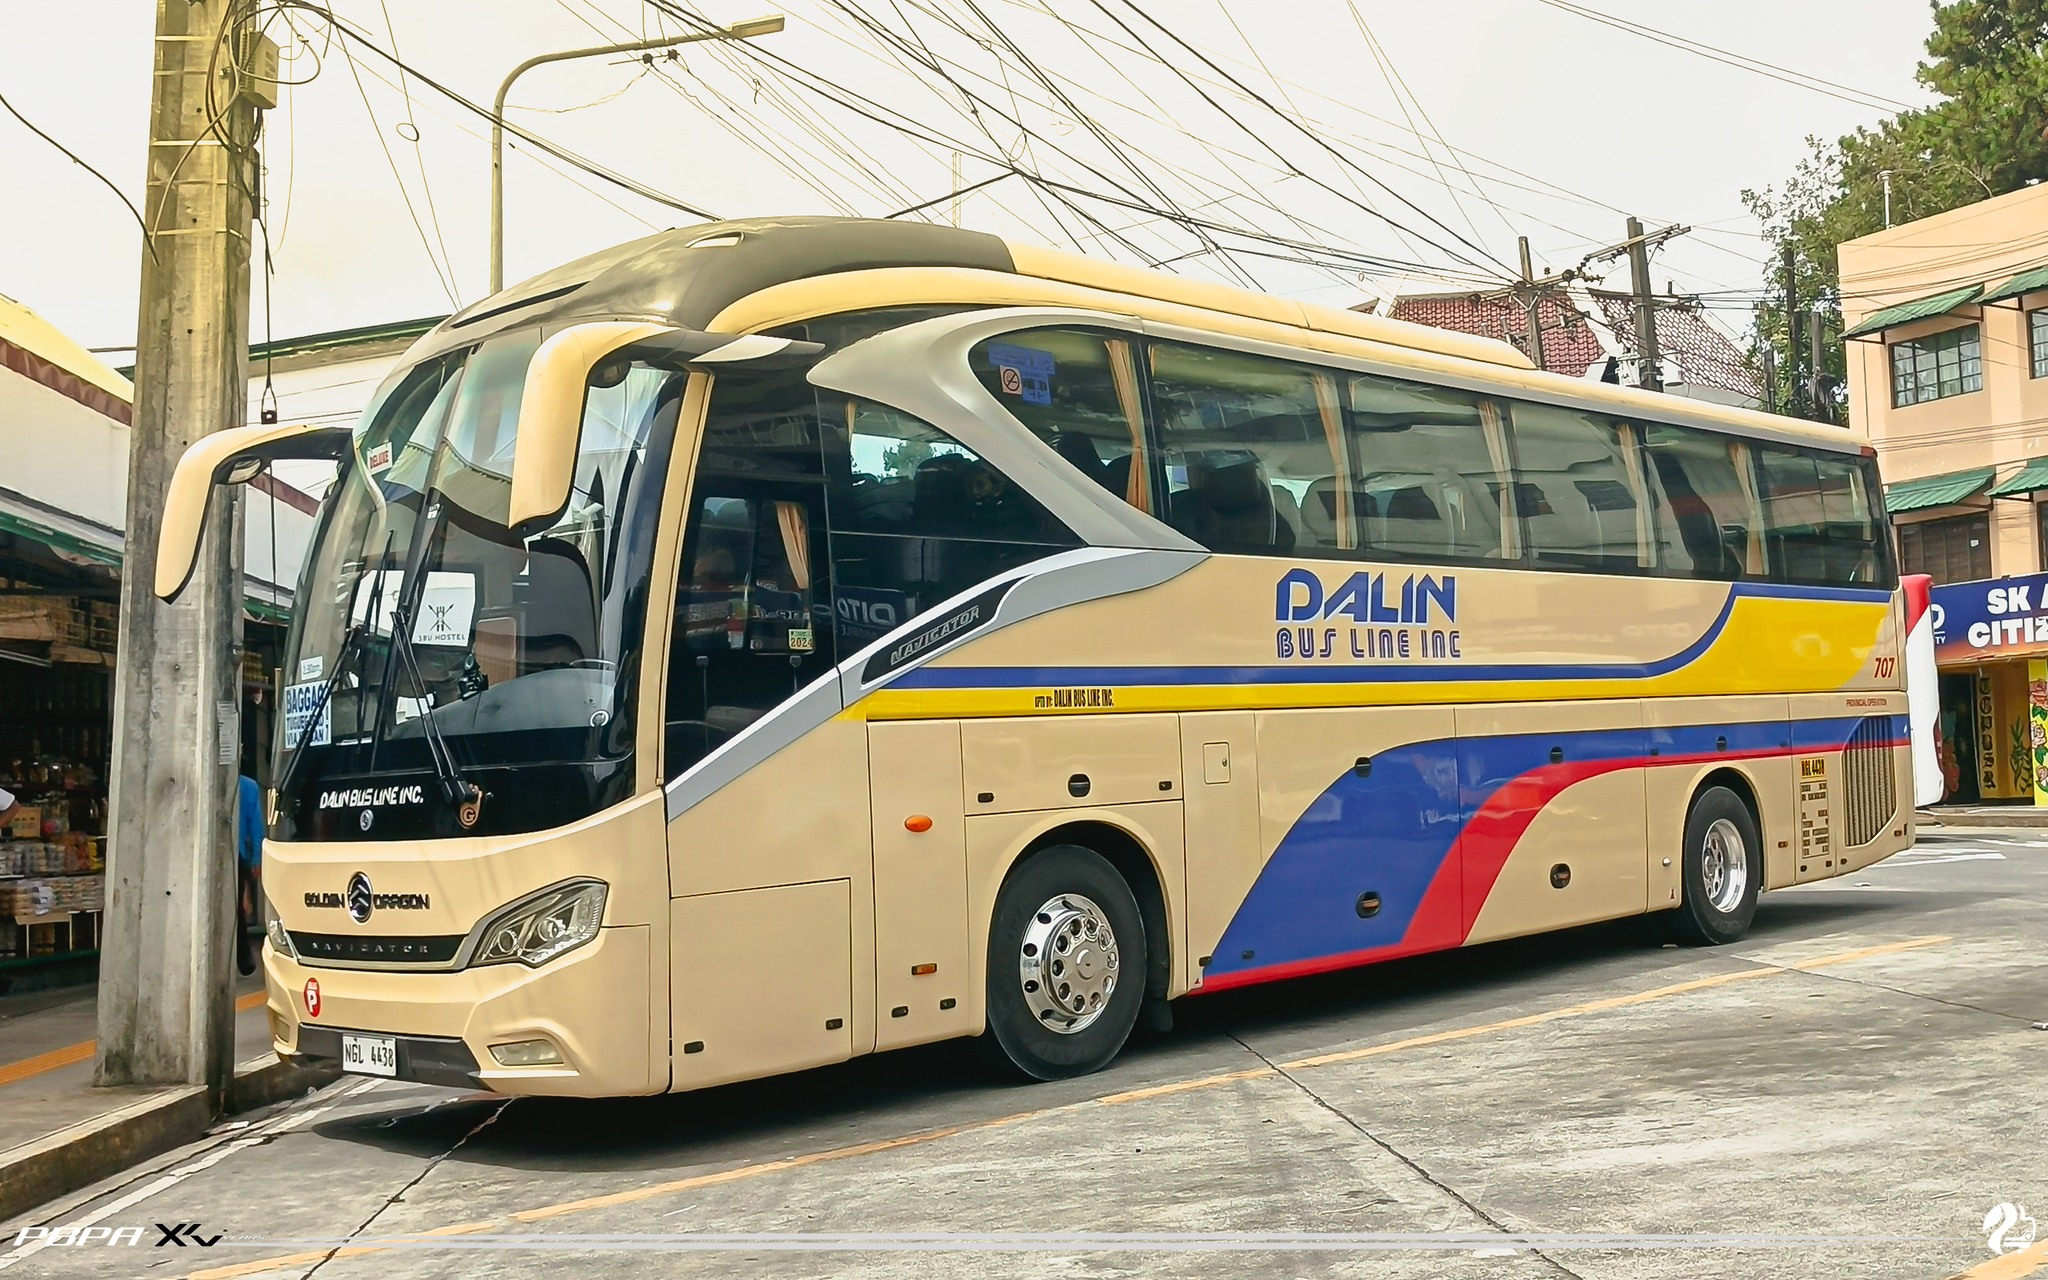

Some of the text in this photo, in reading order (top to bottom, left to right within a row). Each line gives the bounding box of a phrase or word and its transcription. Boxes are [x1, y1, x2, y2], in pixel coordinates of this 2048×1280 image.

[1275, 568, 1456, 624] DALIN
[1987, 585, 2031, 614] SK
[435, 633, 466, 641] HOSTEL
[791, 637, 813, 648] 2024
[891, 605, 980, 666] NAVIGATOR
[1276, 627, 1461, 659] BUS LINE INC
[1874, 657, 1895, 678] 707
[1054, 689, 1072, 707] DALIN
[1074, 689, 1086, 707] BUS
[1087, 688, 1101, 706] LINE
[1102, 688, 1114, 707] INC.
[320, 785, 424, 809] DALIN BUS LINE INC.
[304, 892, 431, 909] GOLDEN DRAGON
[312, 942, 428, 954] NAVIGATOR
[306, 990, 318, 1013] P
[345, 1043, 394, 1067] NGL 4438
